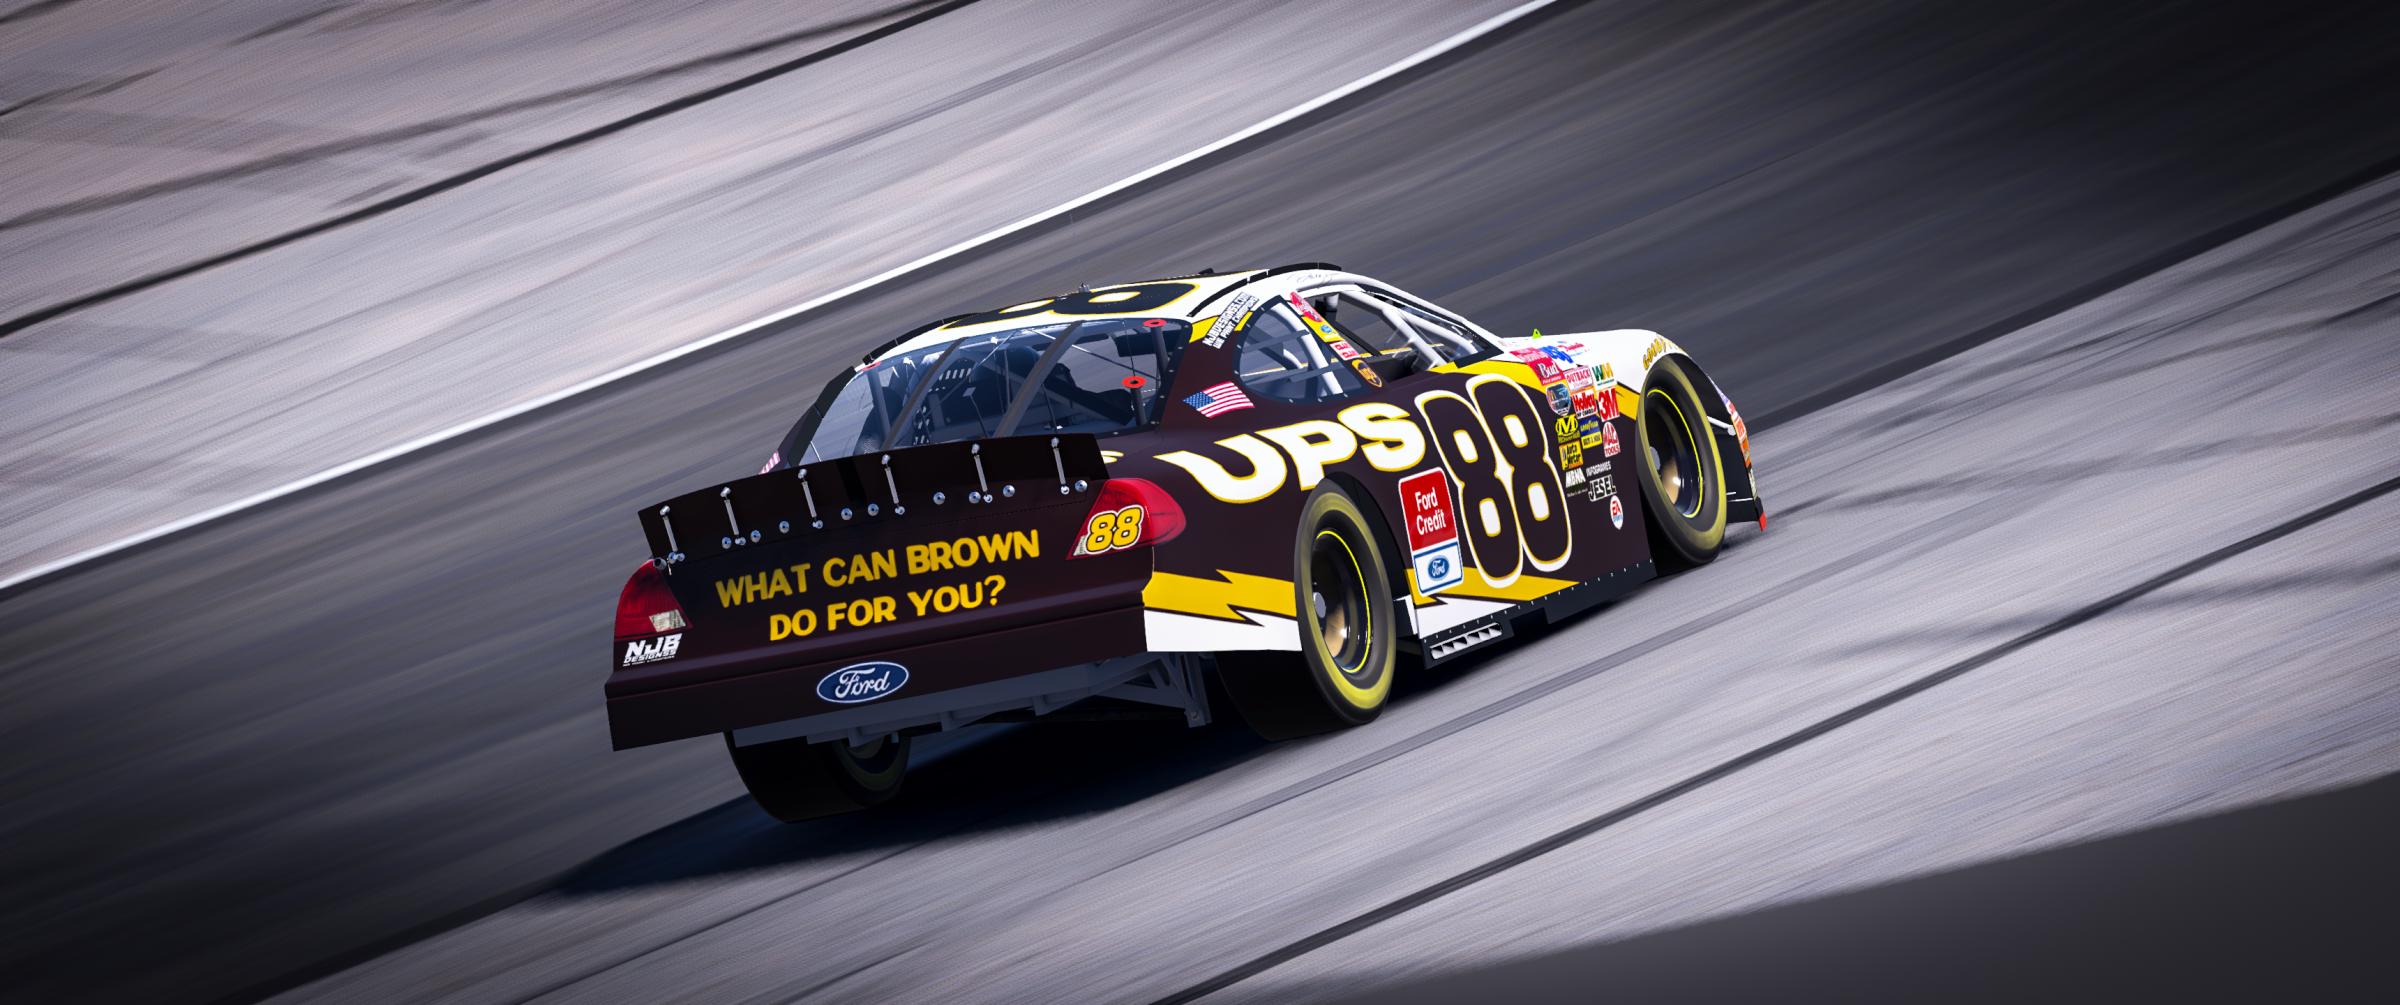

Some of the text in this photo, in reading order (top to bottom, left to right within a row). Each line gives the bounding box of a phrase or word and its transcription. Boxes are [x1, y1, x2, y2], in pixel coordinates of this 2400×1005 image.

[1538, 362, 1560, 379] Bud
[1566, 366, 1591, 385] OUTBACK
[1573, 390, 1597, 414] Holley
[1598, 388, 1620, 420] 3M
[1153, 402, 1427, 505] UPS
[1605, 445, 1619, 455] TOOLS
[1414, 376, 1573, 589] 88
[1588, 475, 1617, 502] JESEL
[1415, 487, 1439, 512] Ford
[1085, 504, 1144, 555] 88
[1416, 508, 1447, 536] Credit
[715, 529, 1040, 609] WHAT CAN BROWN
[769, 574, 1006, 641] DO FOR YOU?
[835, 666, 891, 699] Ford
